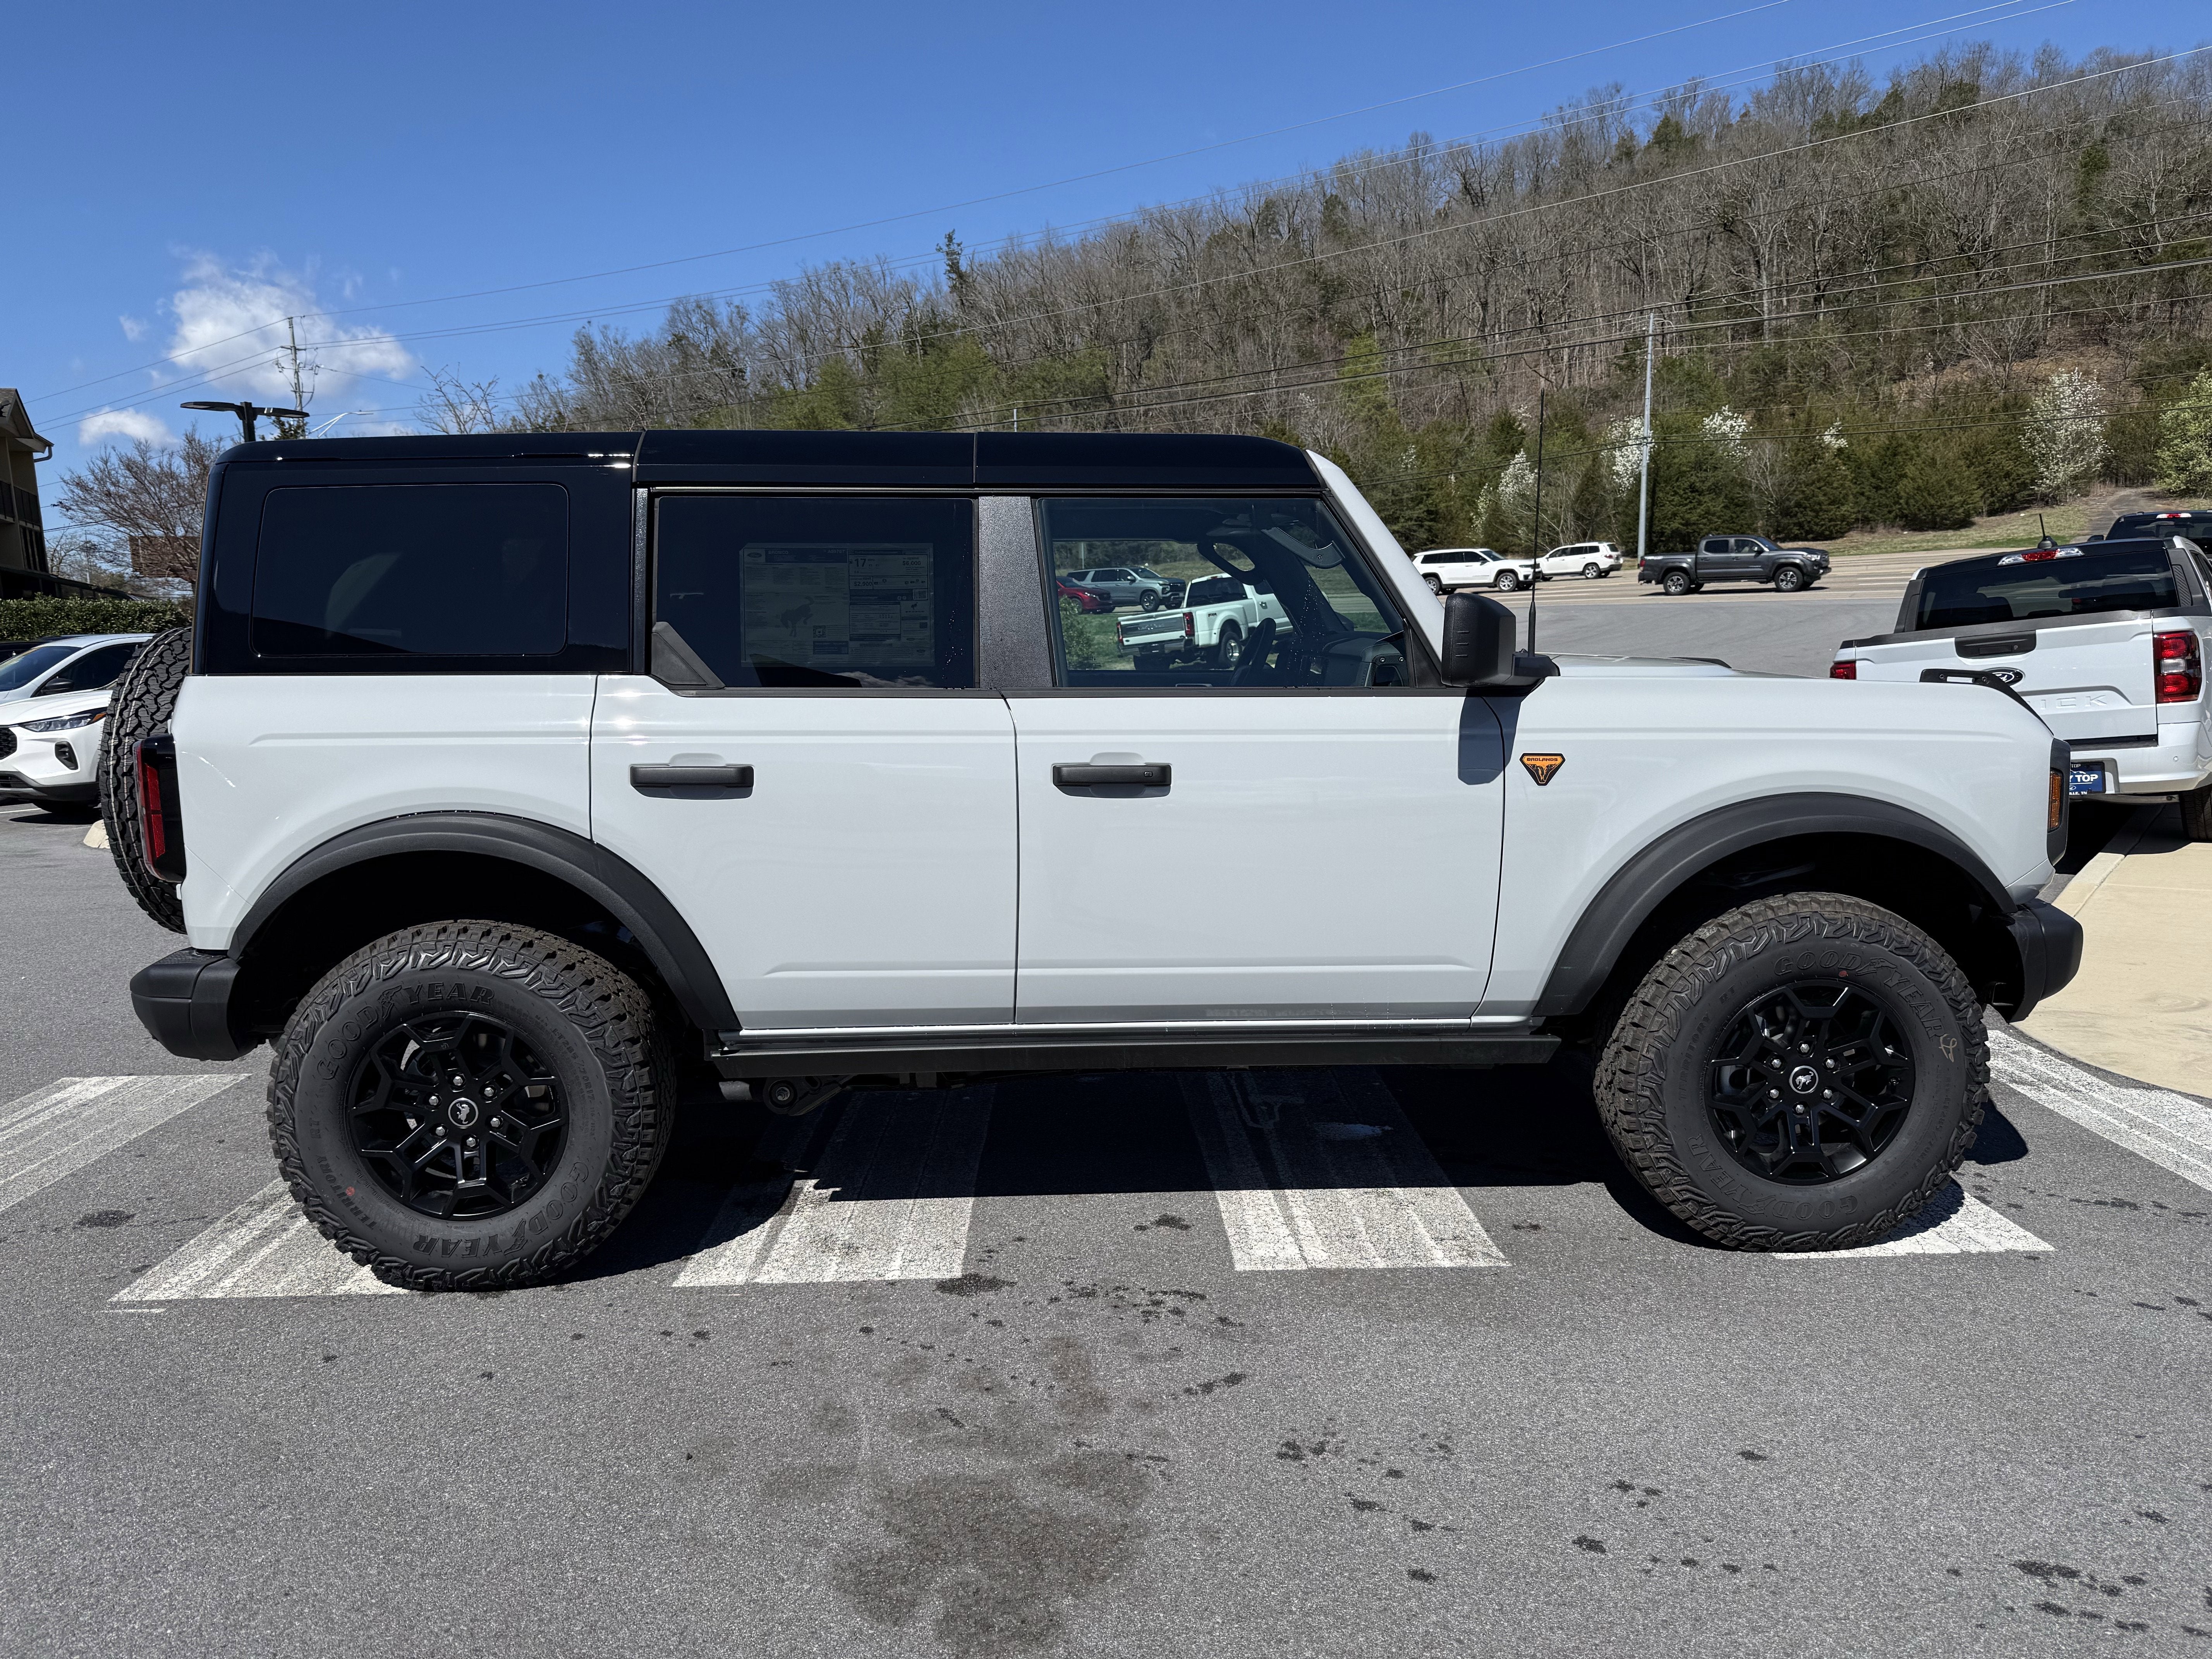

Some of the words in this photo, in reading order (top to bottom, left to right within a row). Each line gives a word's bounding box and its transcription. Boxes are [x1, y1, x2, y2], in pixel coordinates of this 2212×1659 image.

[854, 558, 866, 567] 17
[2075, 774, 2098, 782] TOP
[1678, 1011, 1711, 1100] TERRITORY
[316, 1155, 378, 1230] TERRITORY
